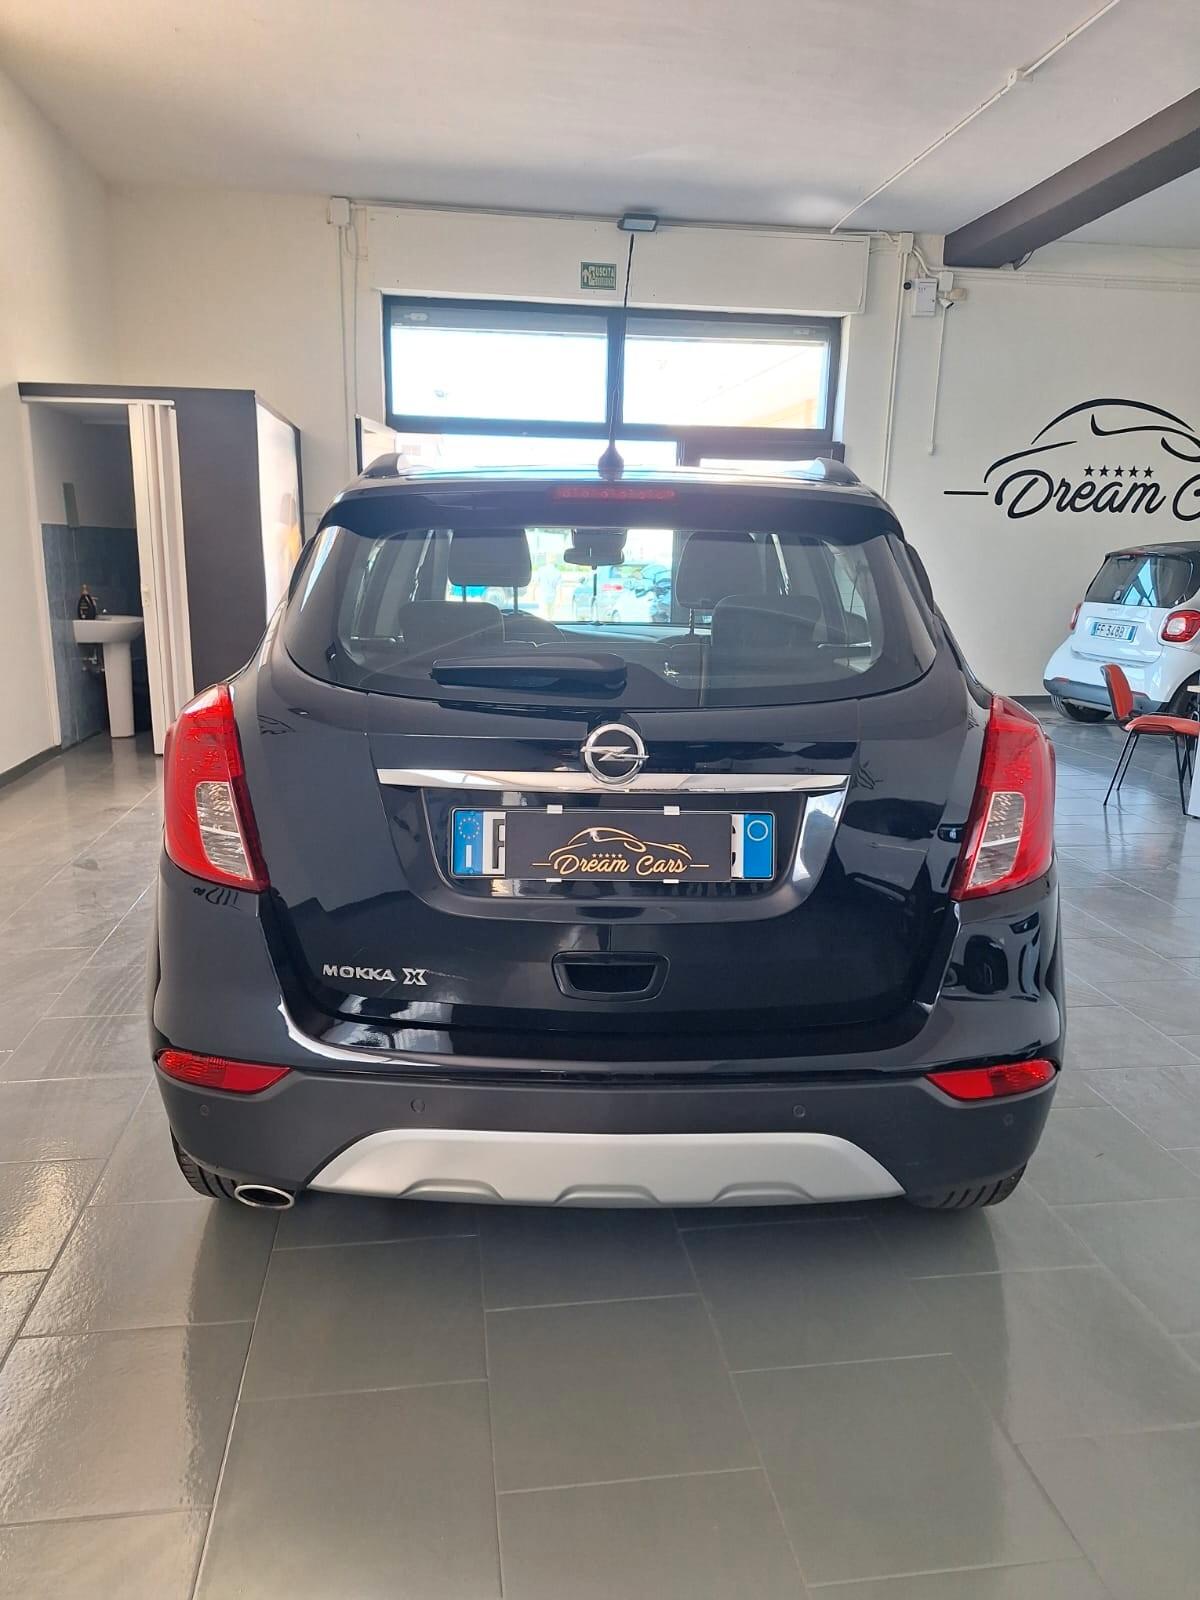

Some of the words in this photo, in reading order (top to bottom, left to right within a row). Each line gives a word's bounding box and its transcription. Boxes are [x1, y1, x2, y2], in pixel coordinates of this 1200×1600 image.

[994, 469, 1166, 520] Dream
[553, 853, 630, 875] Dream
[635, 854, 688, 876] Cars
[322, 963, 397, 982] MOKKA
[401, 967, 428, 986] X
